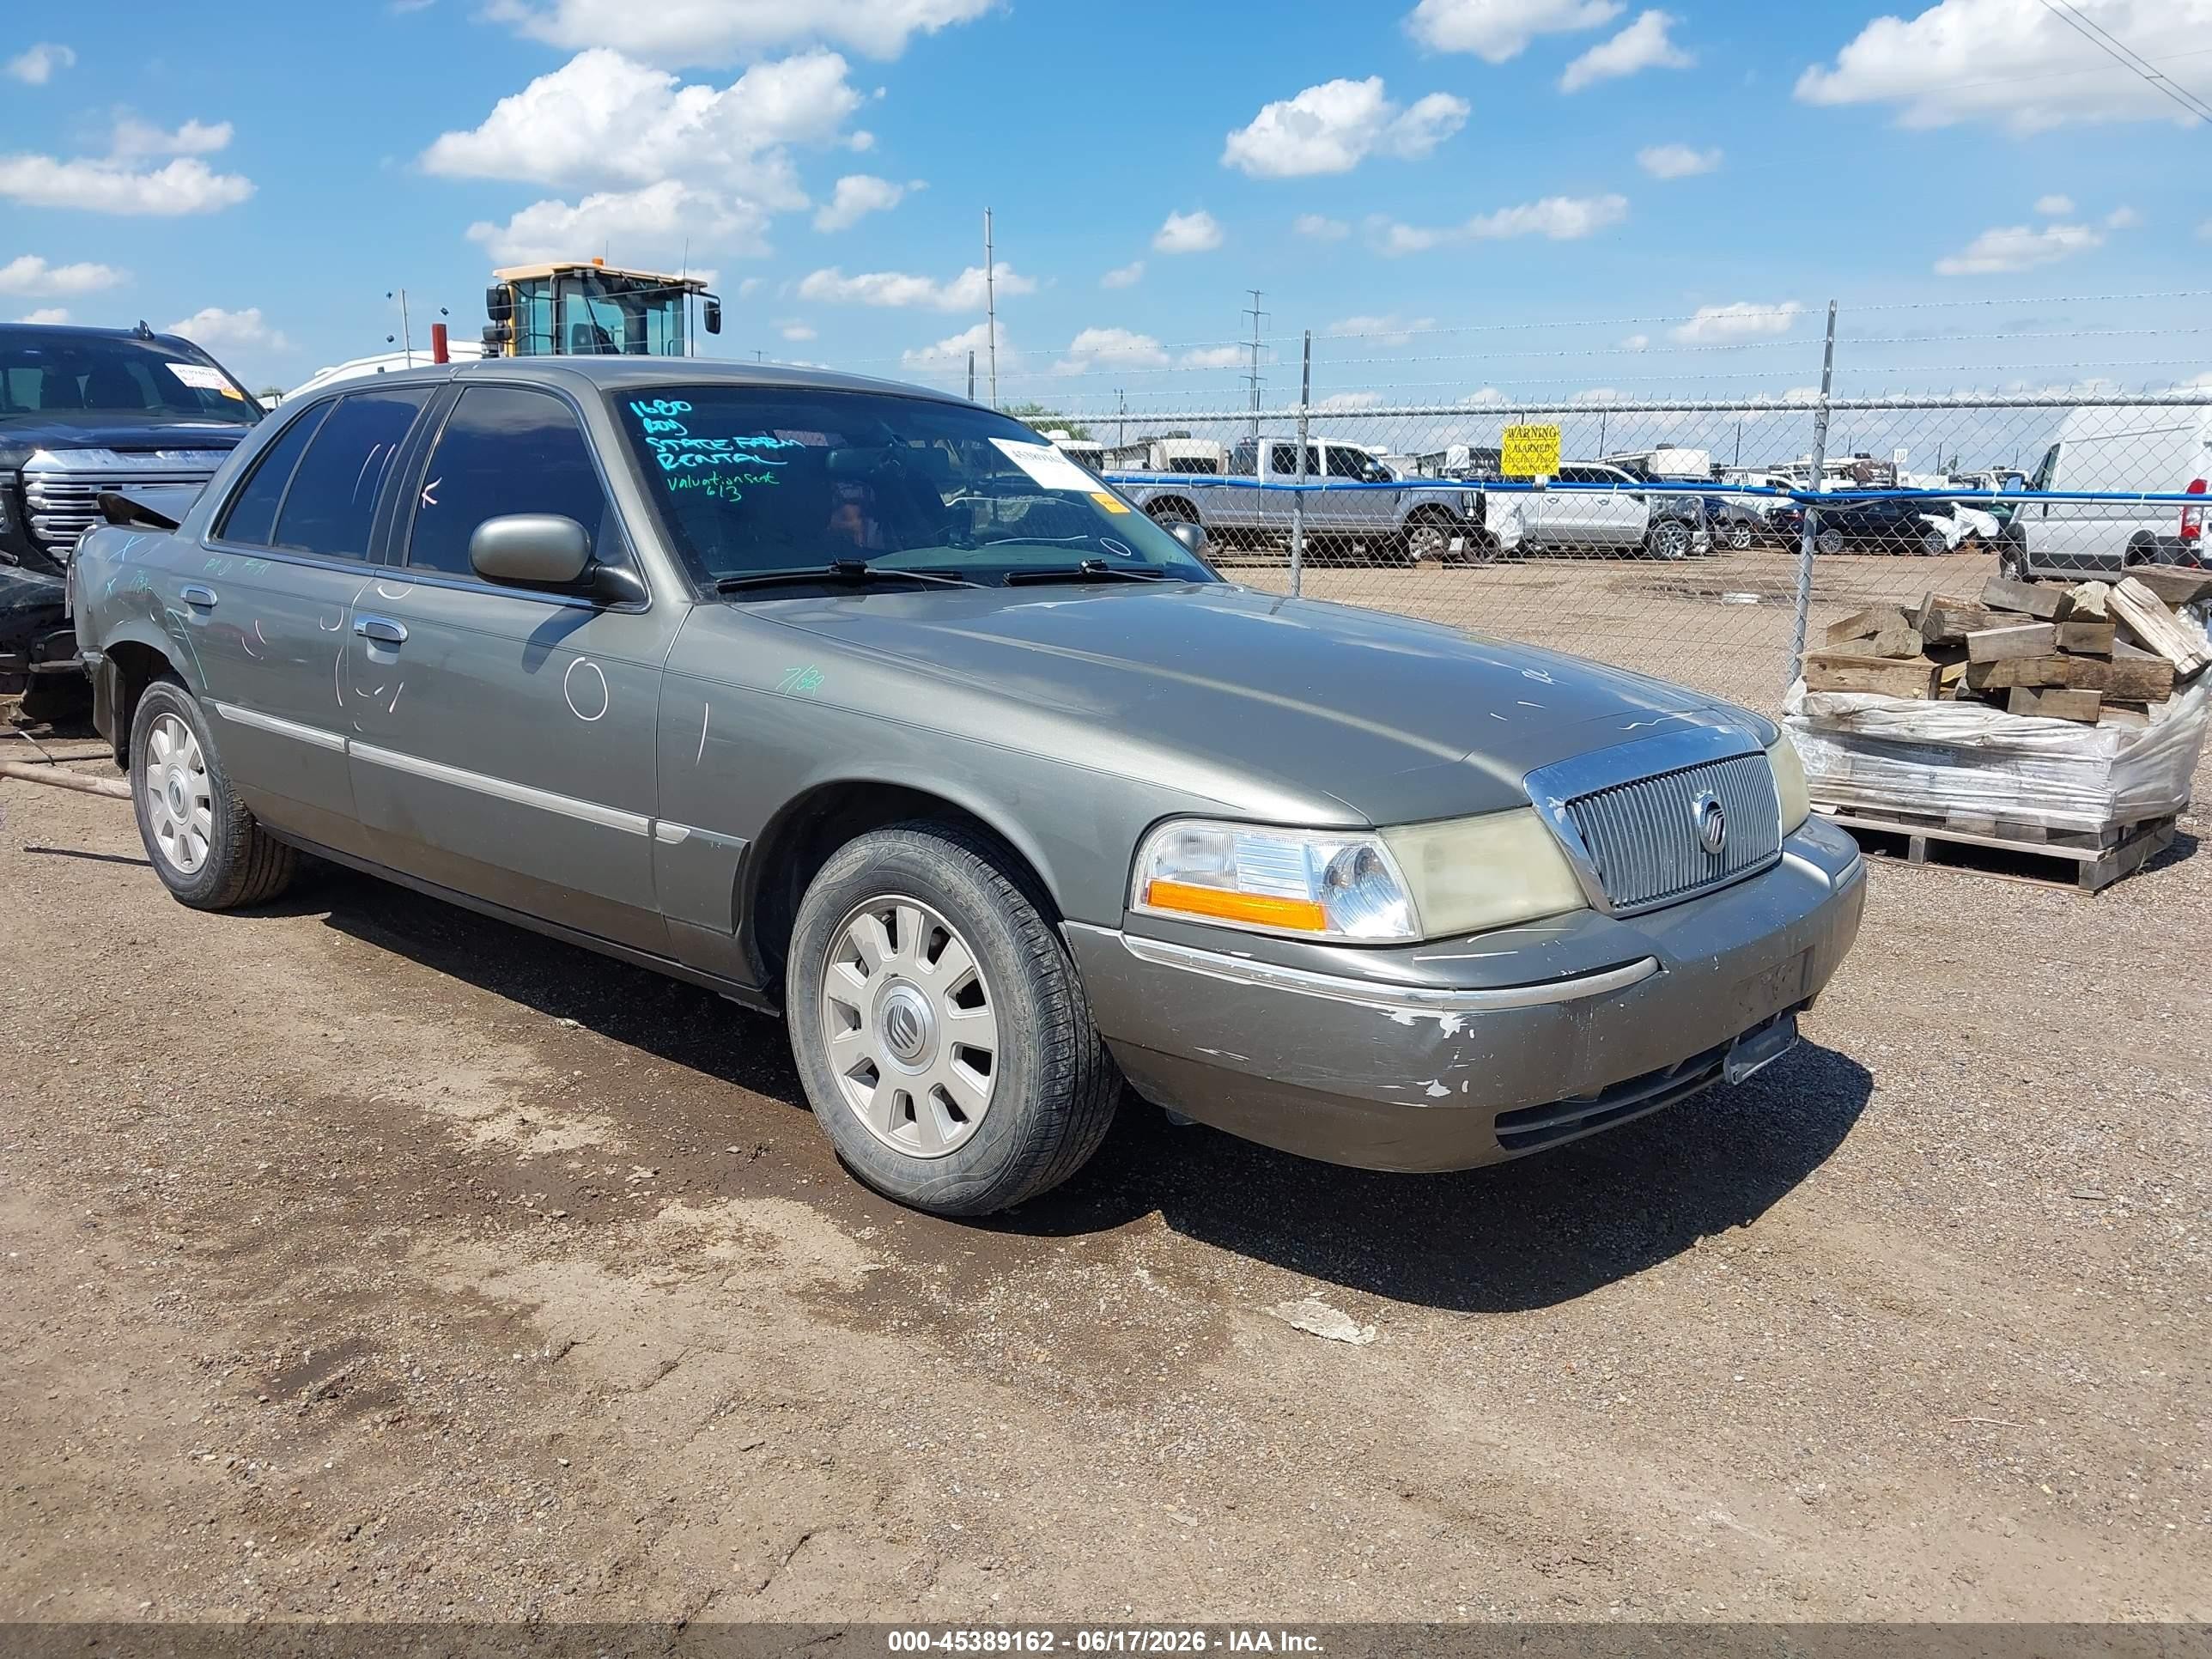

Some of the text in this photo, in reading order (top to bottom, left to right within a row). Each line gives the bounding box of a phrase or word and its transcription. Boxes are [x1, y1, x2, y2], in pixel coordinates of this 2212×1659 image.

[629, 398, 692, 417] 1680
[1507, 428, 1557, 439] WARNING
[645, 436, 733, 453] STATE
[1512, 443, 1550, 454] ALARMED
[656, 453, 789, 471] RENTAL
[1895, 450, 1906, 461] 10
